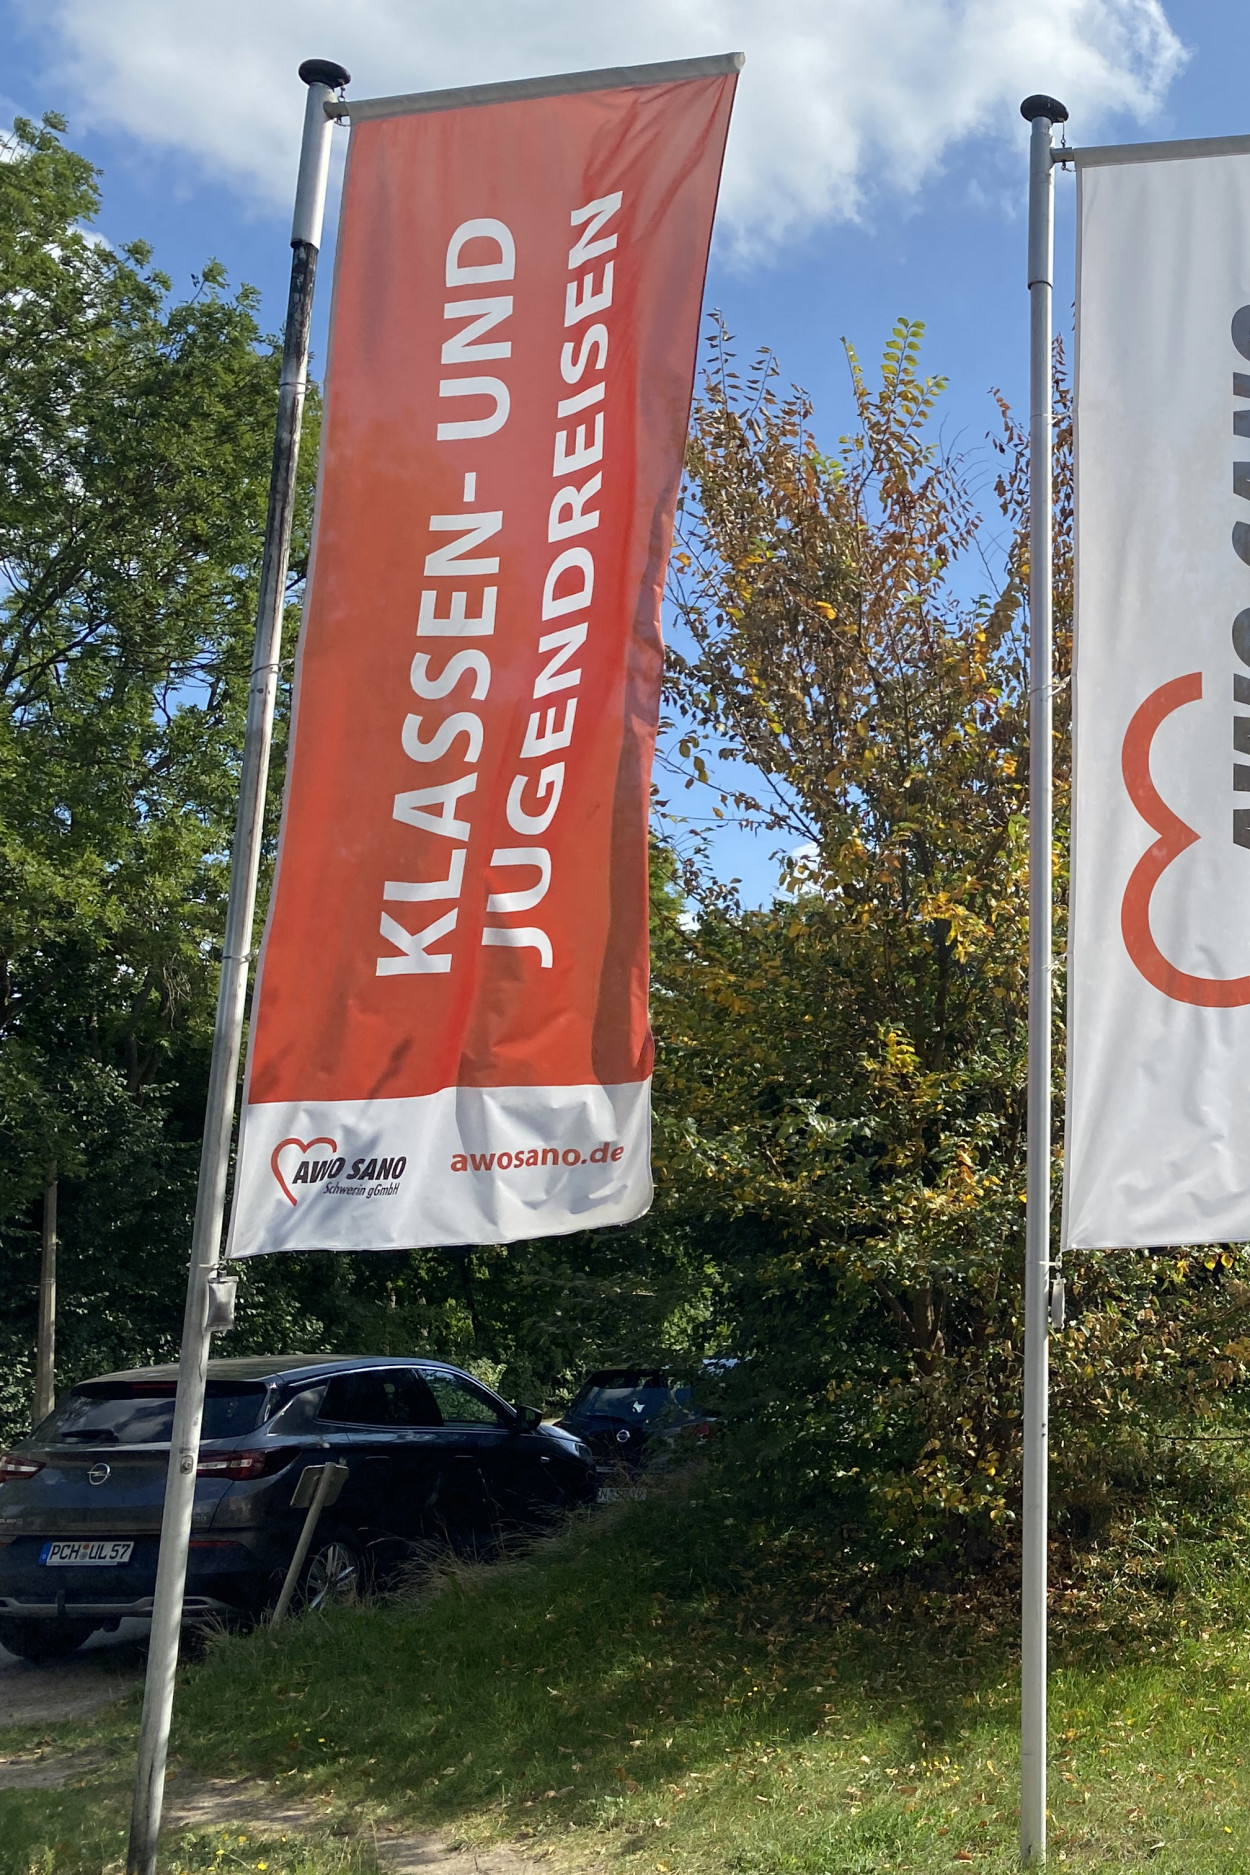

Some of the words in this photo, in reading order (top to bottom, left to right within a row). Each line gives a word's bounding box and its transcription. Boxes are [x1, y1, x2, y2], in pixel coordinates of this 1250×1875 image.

[436, 217, 516, 441] UND
[481, 190, 624, 969] JUGENDREISEN
[376, 471, 503, 977] KLASSEN-
[291, 1157, 346, 1184] AWO
[346, 1156, 407, 1181] SANO
[450, 1141, 625, 1173] awosano.de
[323, 1181, 366, 1196] Schwerin
[367, 1182, 400, 1199] gGmbH
[50, 1544, 81, 1560] PCH
[88, 1544, 107, 1559] UL
[109, 1544, 131, 1559] 57
